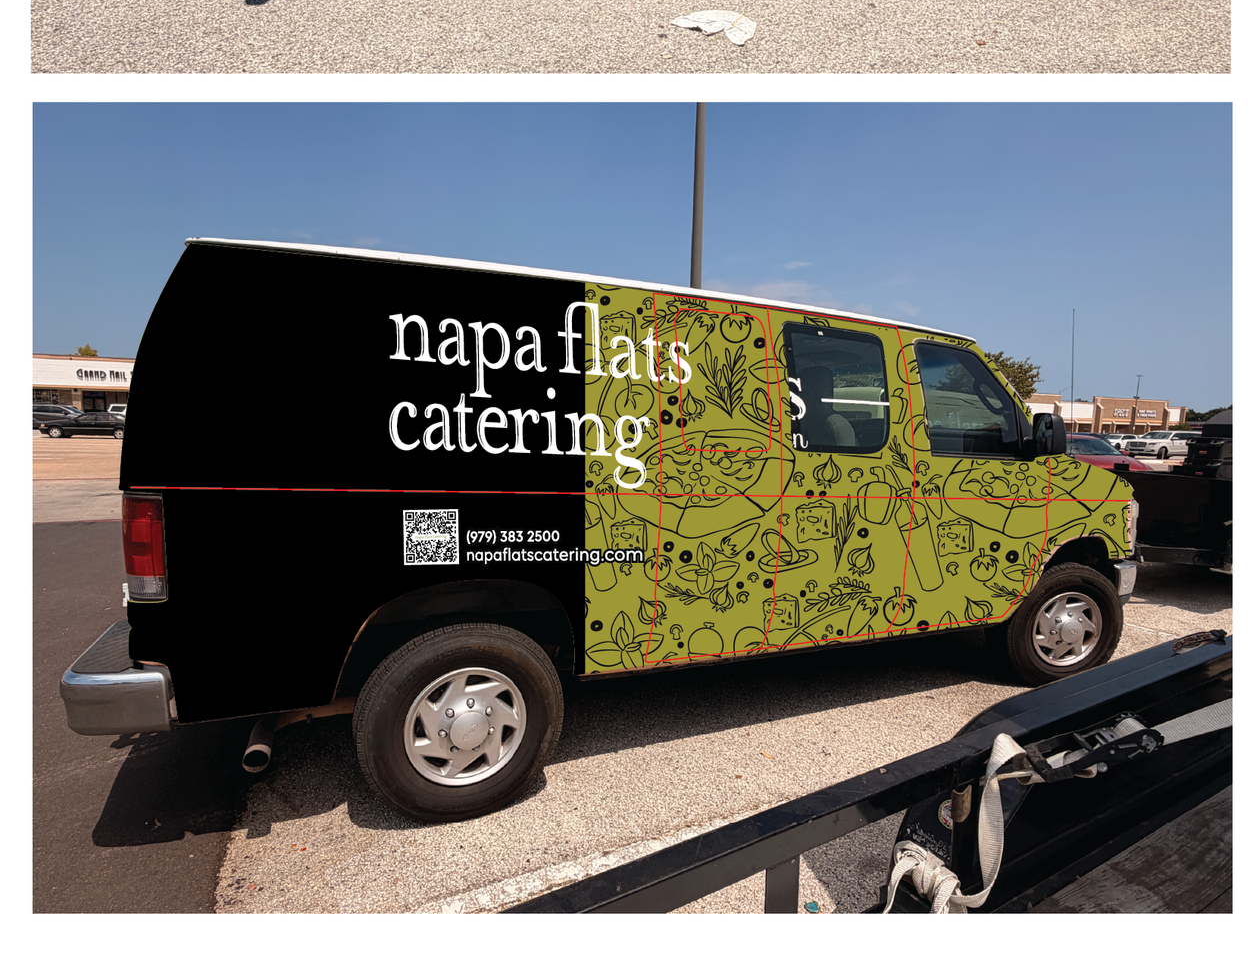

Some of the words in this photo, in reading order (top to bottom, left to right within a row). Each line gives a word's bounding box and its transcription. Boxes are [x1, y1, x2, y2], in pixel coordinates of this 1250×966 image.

[388, 312, 548, 399] napa
[557, 301, 692, 384] flats
[388, 388, 651, 490] catering
[466, 530, 497, 545] (979)
[500, 530, 524, 543] 383
[527, 529, 560, 543] 2500
[466, 547, 644, 565] napaflatscatering.com
